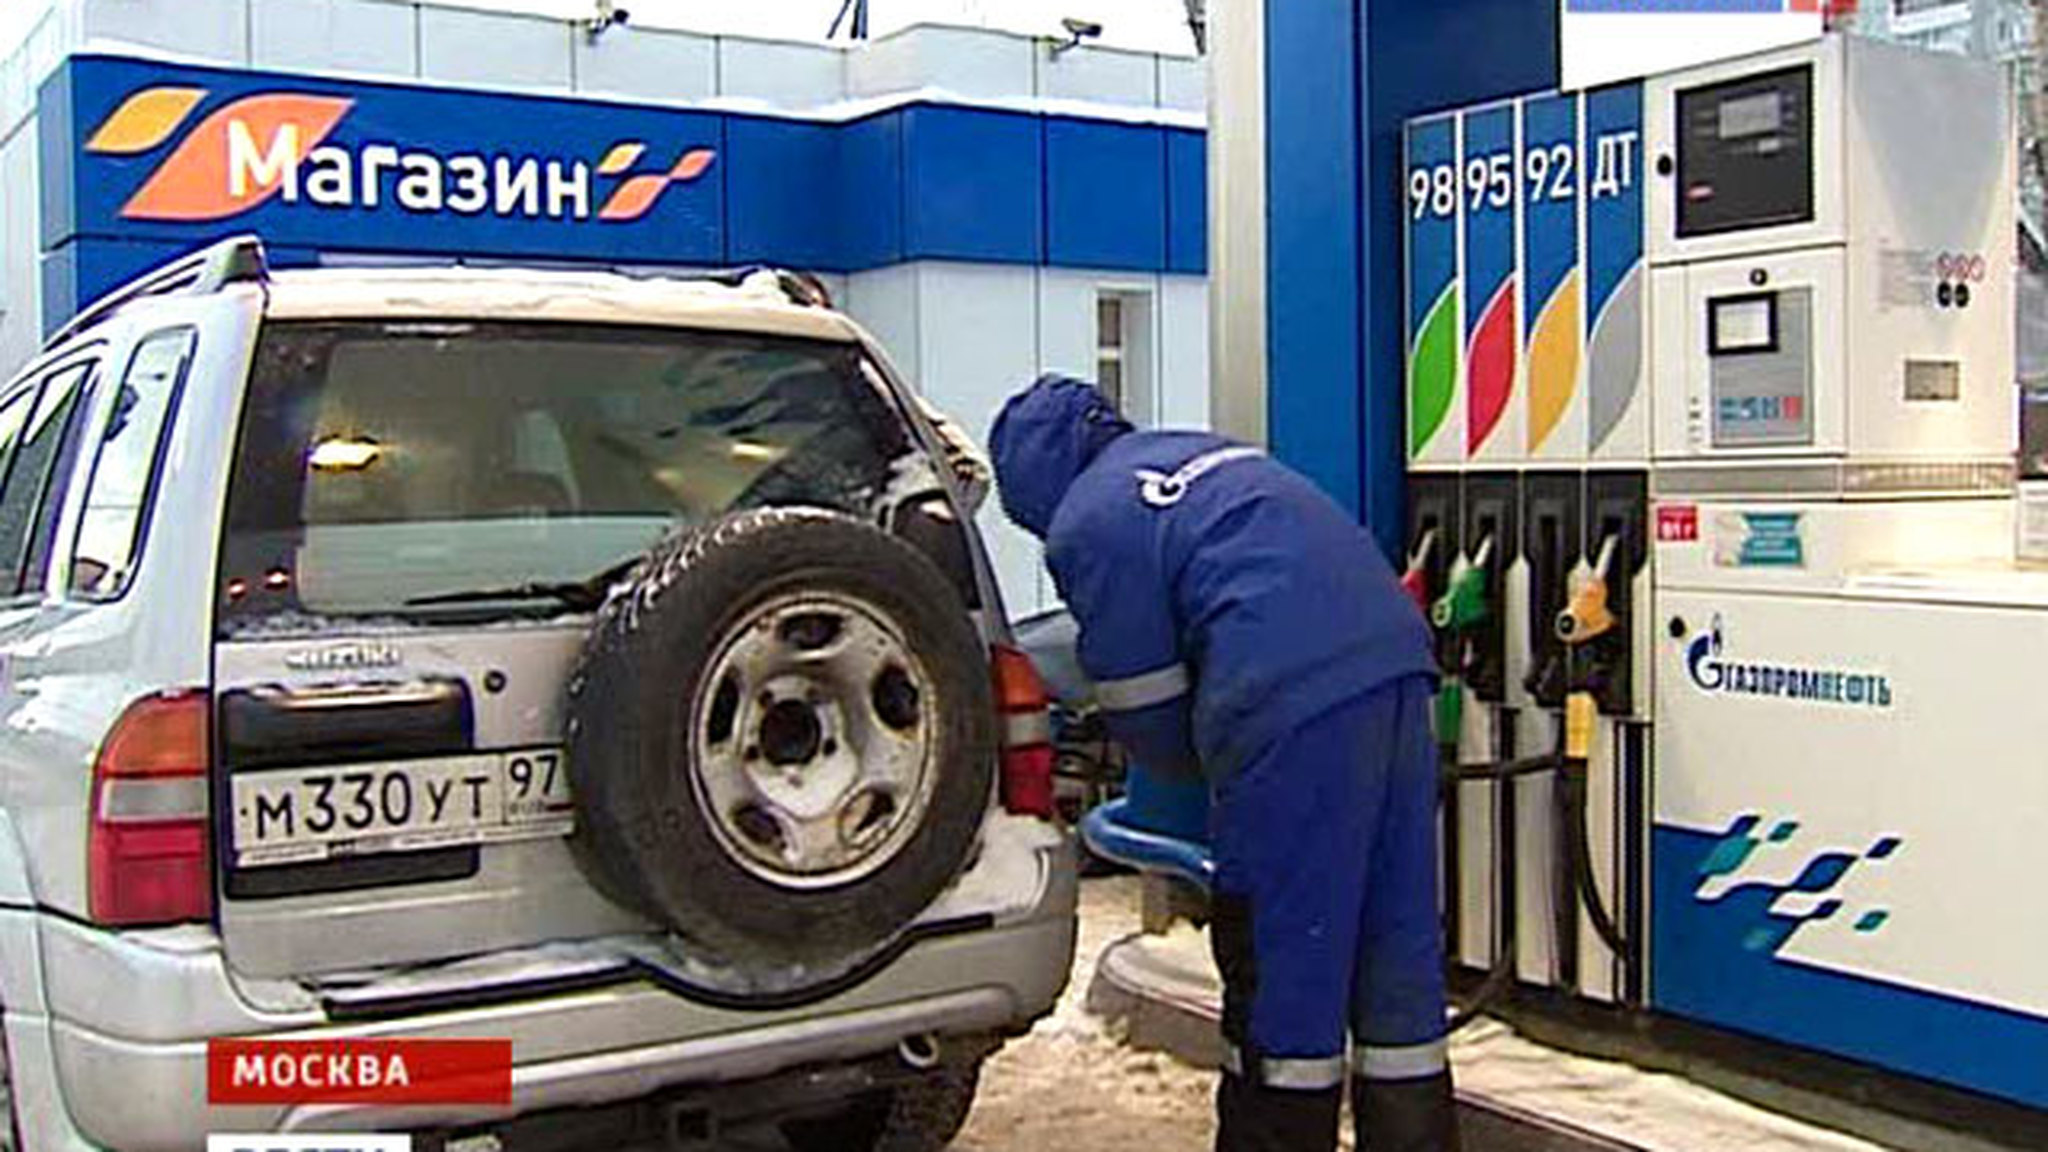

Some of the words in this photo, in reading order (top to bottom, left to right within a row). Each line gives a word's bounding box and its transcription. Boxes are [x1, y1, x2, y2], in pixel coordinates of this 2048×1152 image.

[228, 119, 591, 218] Магазин
[1410, 165, 1453, 219] 98
[1467, 154, 1511, 210] 95
[1527, 144, 1574, 202] 92
[1592, 131, 1638, 199] ДТ
[509, 754, 558, 798] 97
